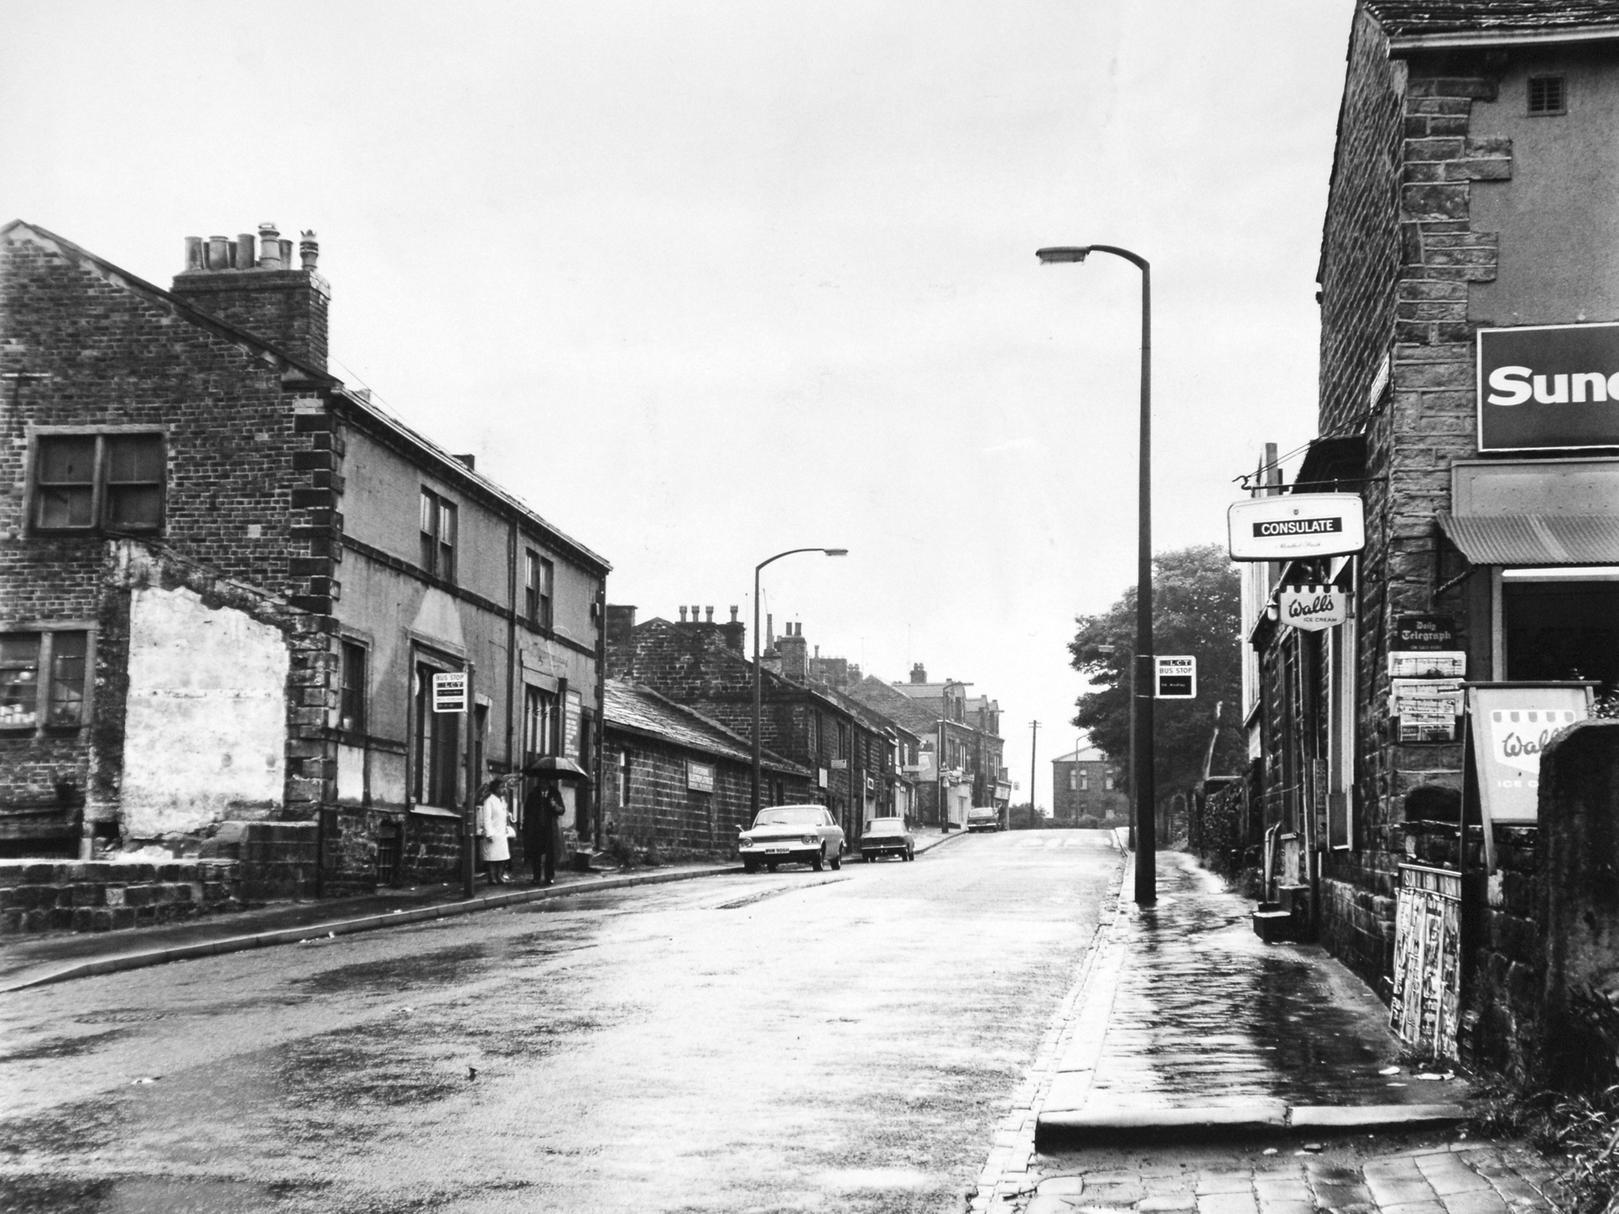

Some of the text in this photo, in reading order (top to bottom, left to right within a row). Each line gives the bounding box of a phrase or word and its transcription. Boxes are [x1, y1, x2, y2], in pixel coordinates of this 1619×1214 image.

[1261, 519, 1334, 535] CONSULATE
[1288, 594, 1335, 618] Wall's
[1416, 620, 1437, 631] Daily
[1401, 630, 1452, 642] Telegraph
[450, 673, 465, 681] STOP
[1497, 779, 1523, 788] ICE
